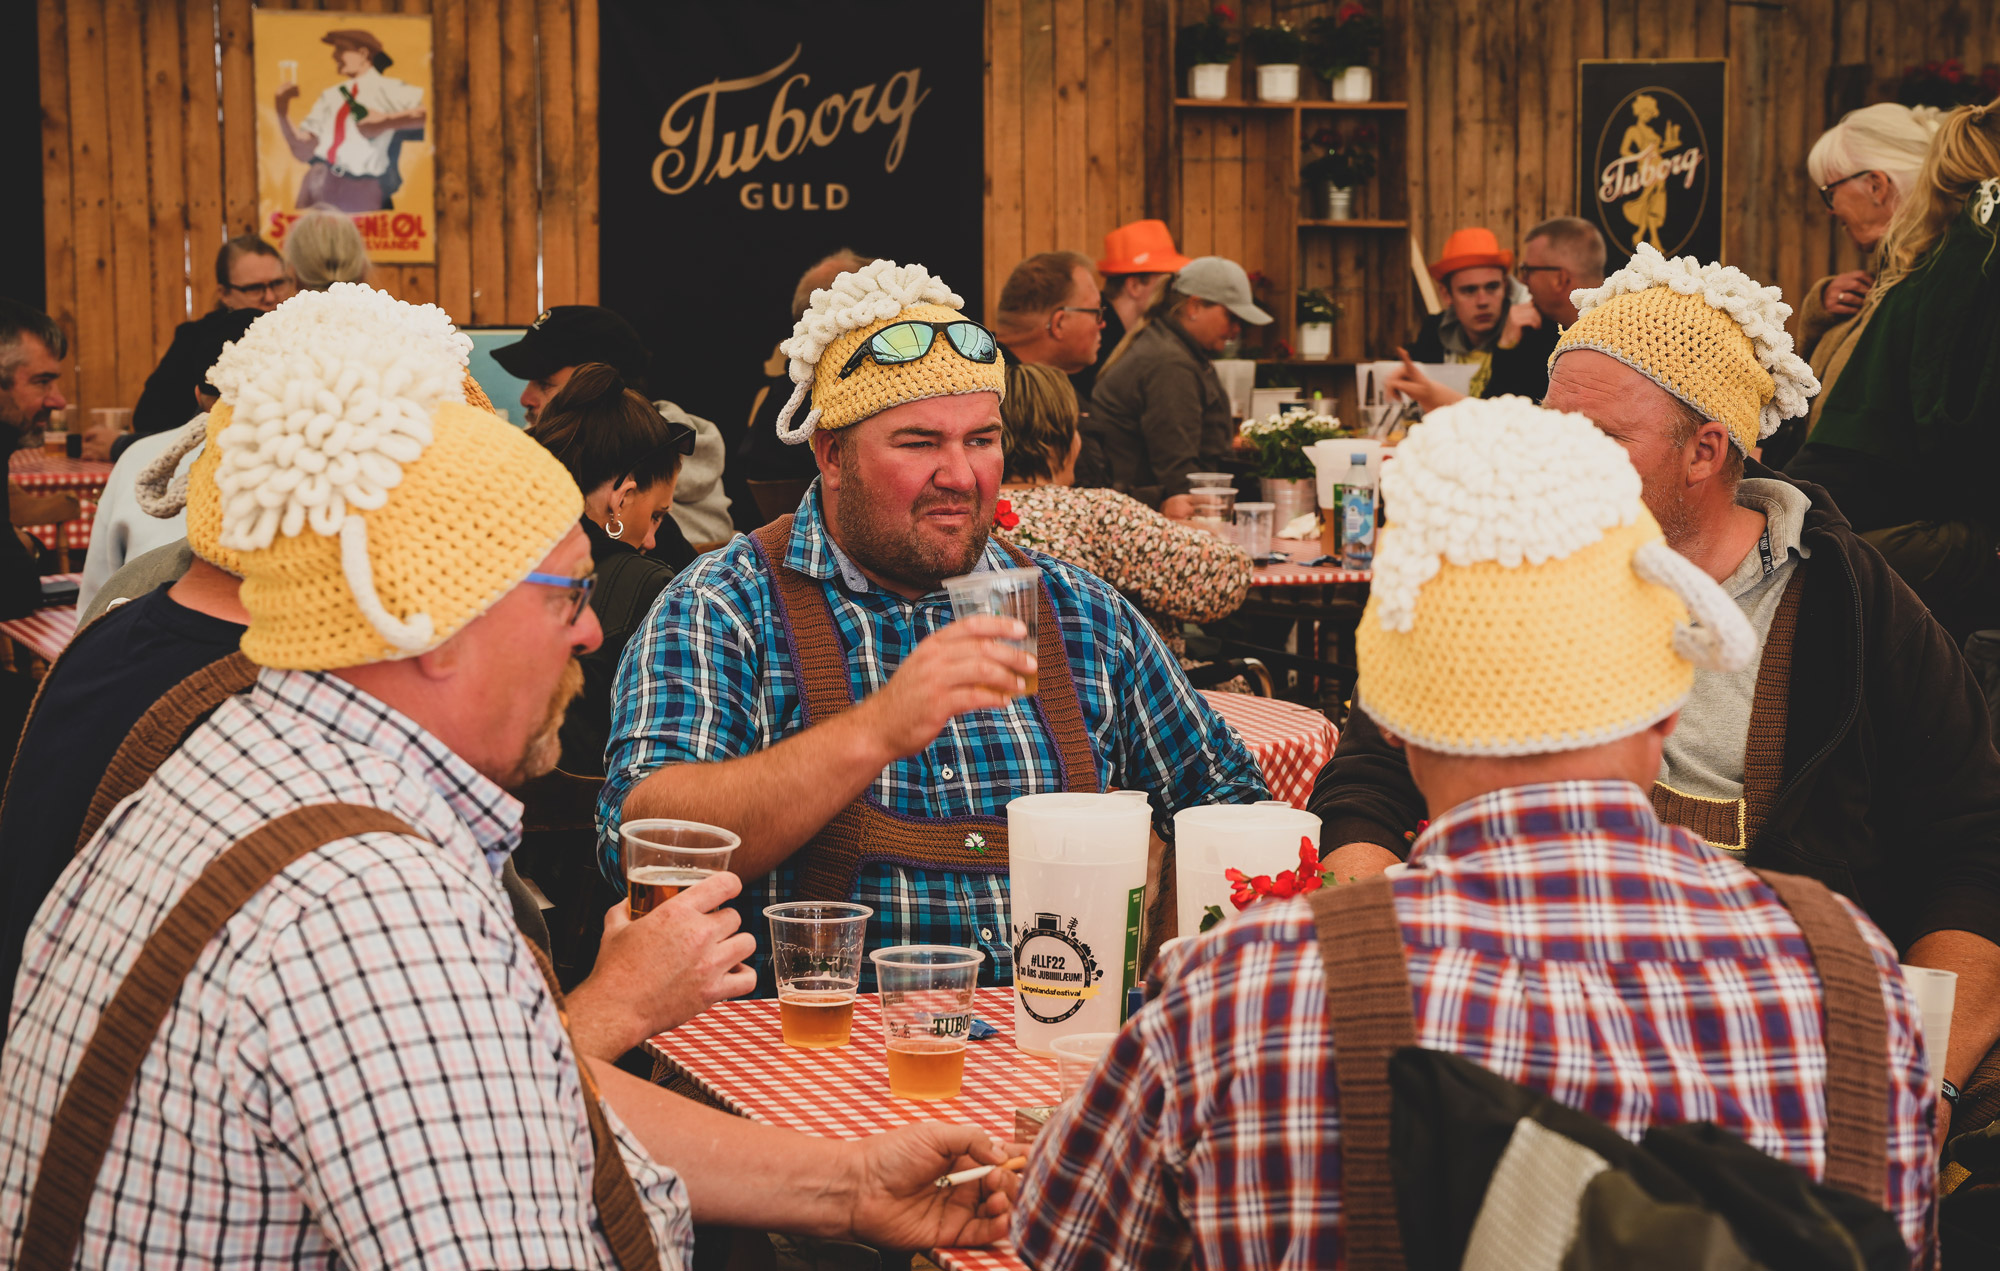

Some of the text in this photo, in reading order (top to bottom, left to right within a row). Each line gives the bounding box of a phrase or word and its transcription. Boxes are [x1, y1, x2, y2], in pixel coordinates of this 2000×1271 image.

[651, 42, 931, 195] Tuborg
[1599, 143, 1704, 203] Tuborg
[739, 182, 849, 211] GULD
[391, 212, 427, 238] ØL
[1031, 954, 1065, 970] #LLF22
[1021, 984, 1081, 997] Langelandsfestival
[933, 1013, 971, 1036] TUBO
